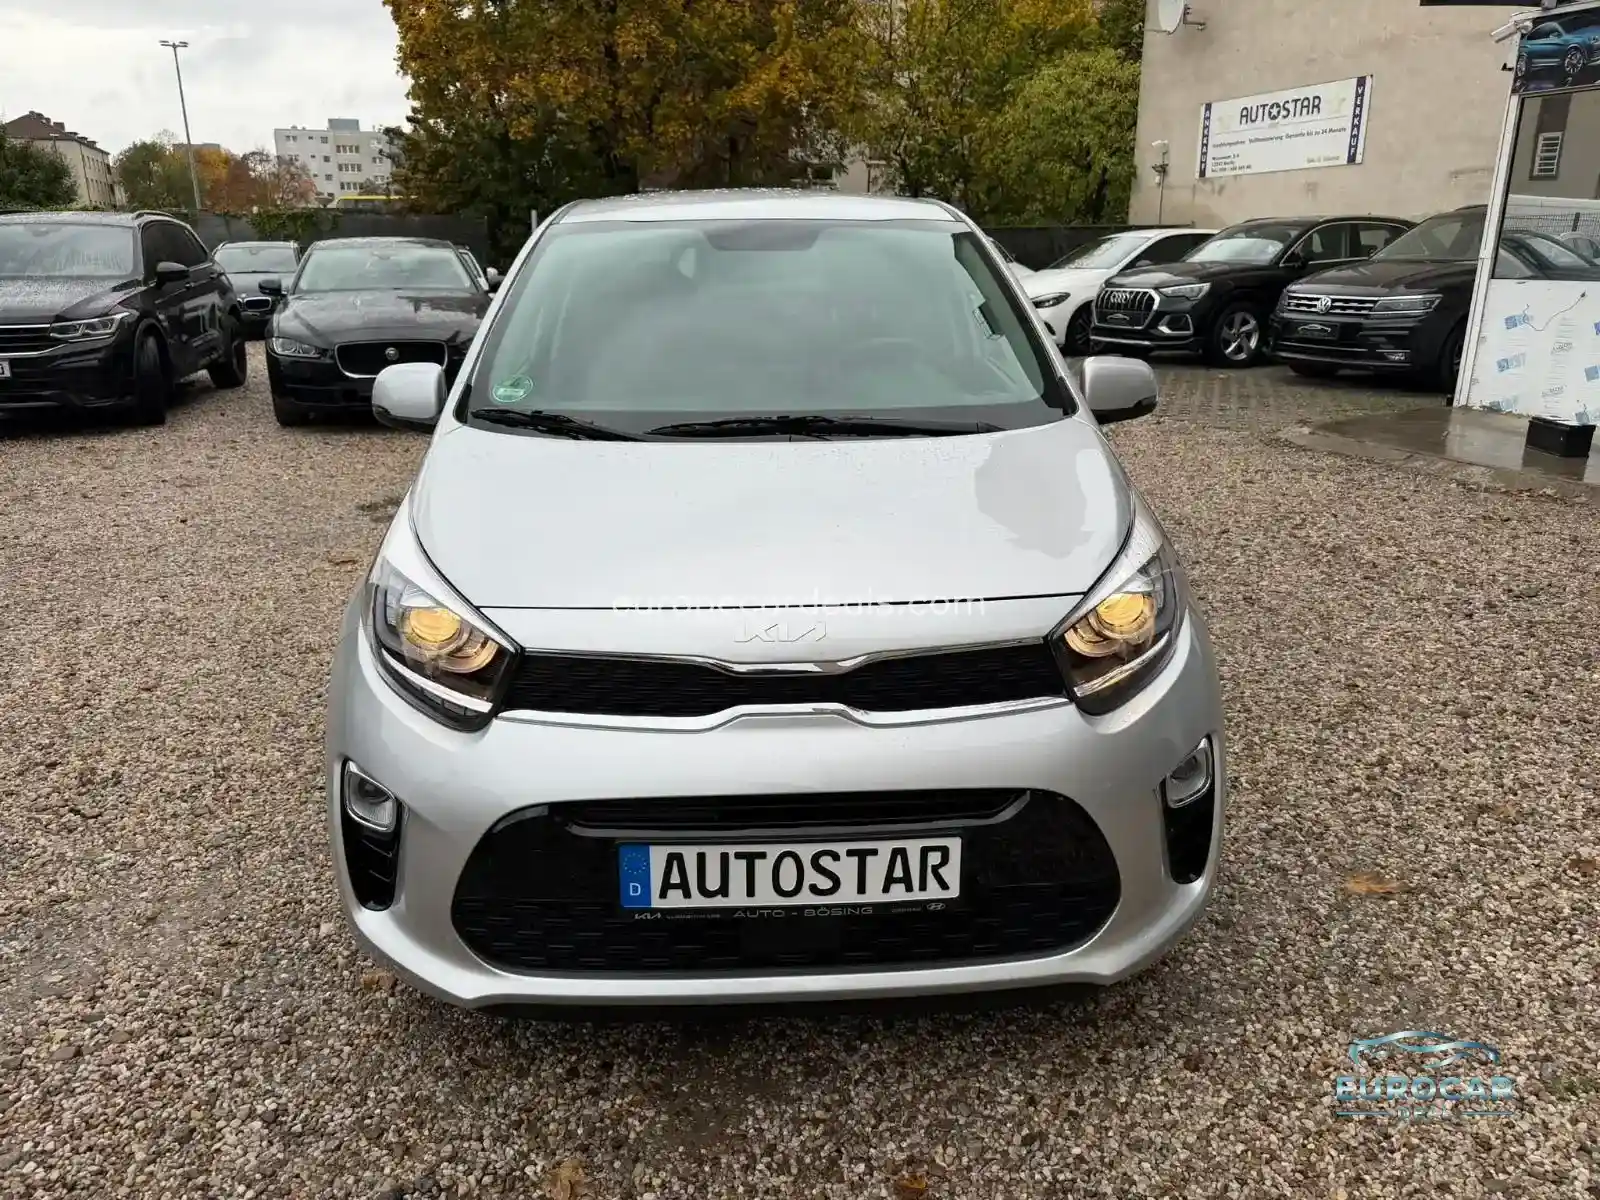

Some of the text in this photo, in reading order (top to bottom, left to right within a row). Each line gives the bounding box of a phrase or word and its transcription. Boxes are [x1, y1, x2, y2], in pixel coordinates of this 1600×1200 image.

[1240, 96, 1322, 125] AUTOSTAR
[1350, 86, 1363, 156] VERKAUF
[658, 845, 951, 900] AUTOSTAR
[629, 882, 642, 896] D
[733, 909, 785, 919] AUTO
[804, 906, 873, 917] BÖSING
